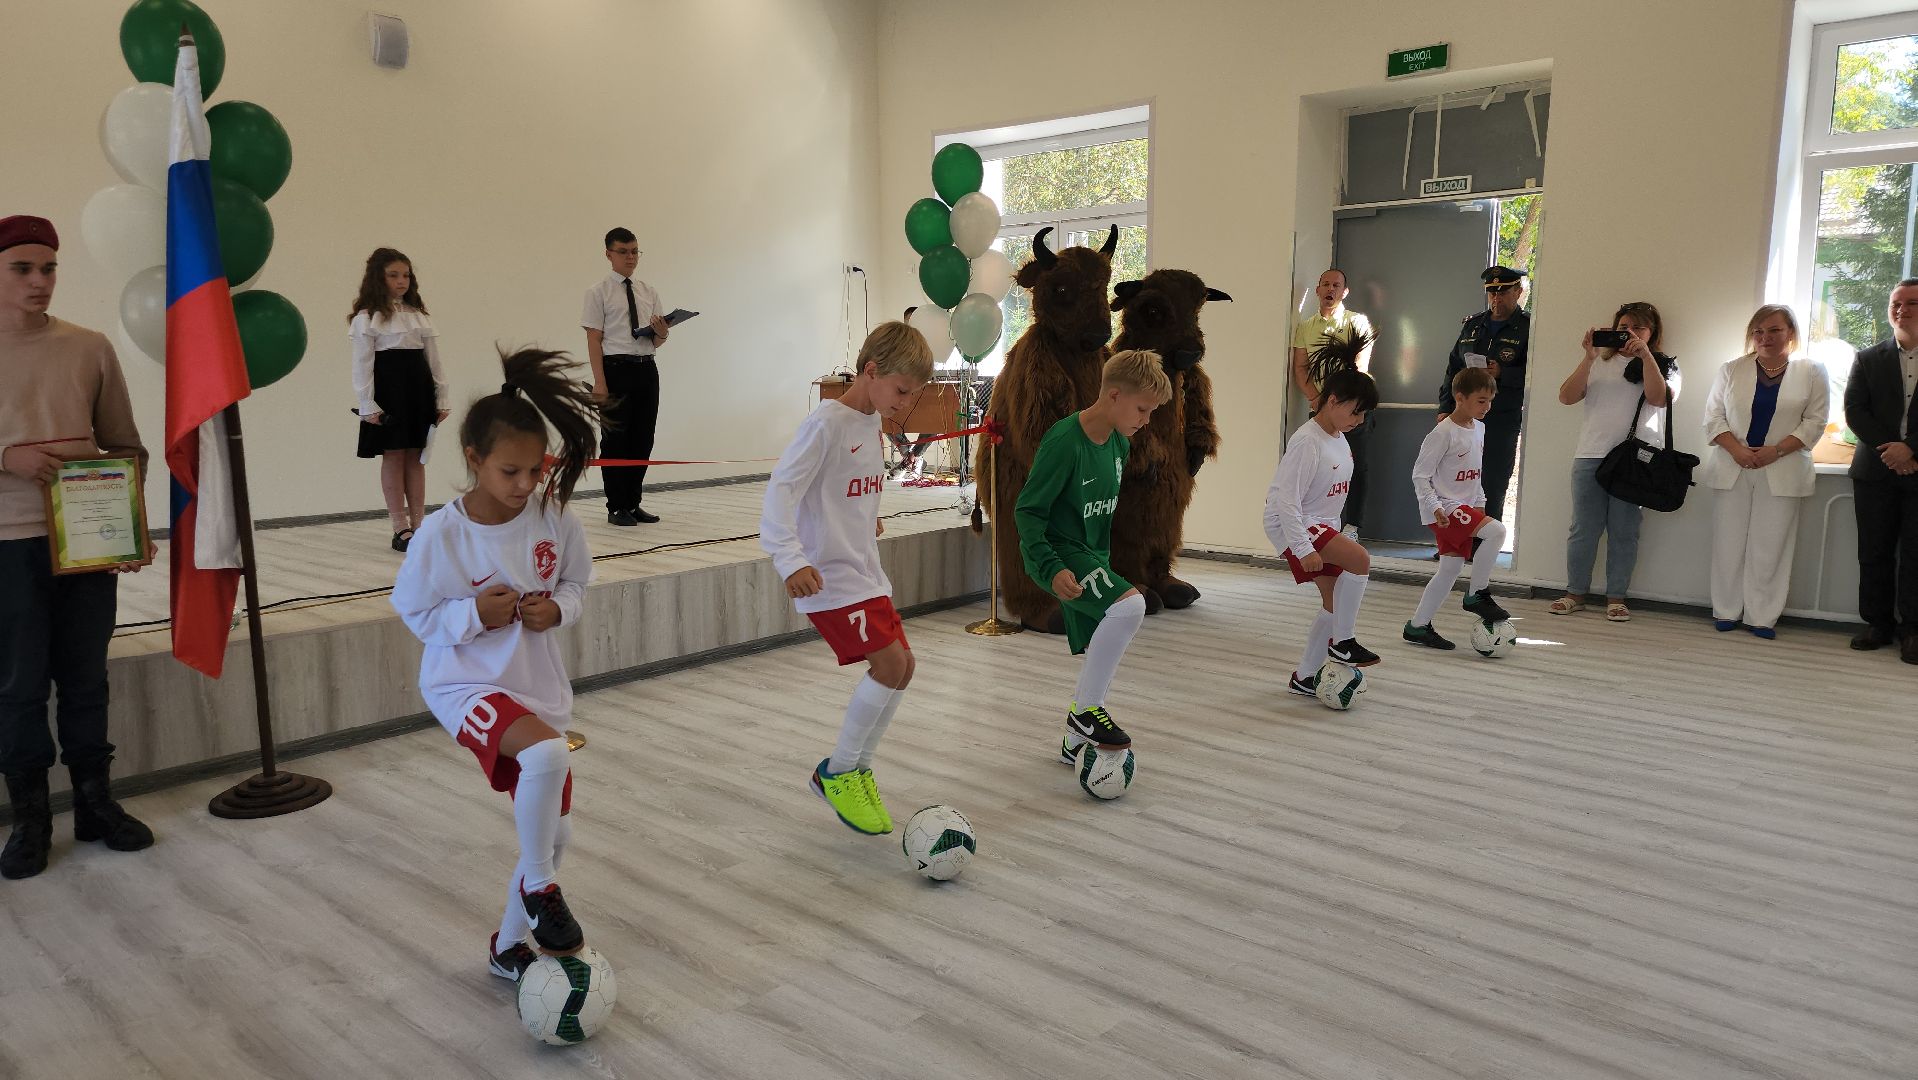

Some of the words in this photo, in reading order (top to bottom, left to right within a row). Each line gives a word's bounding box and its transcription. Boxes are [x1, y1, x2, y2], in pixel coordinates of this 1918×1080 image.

[1403, 50, 1432, 63] ВЫХОД
[1409, 62, 1427, 71] EXIT
[1425, 179, 1466, 193] ВЫХОД
[1453, 508, 1472, 525] 8
[1080, 567, 1115, 599] 77
[848, 609, 870, 643] 7
[463, 699, 498, 747] 10
